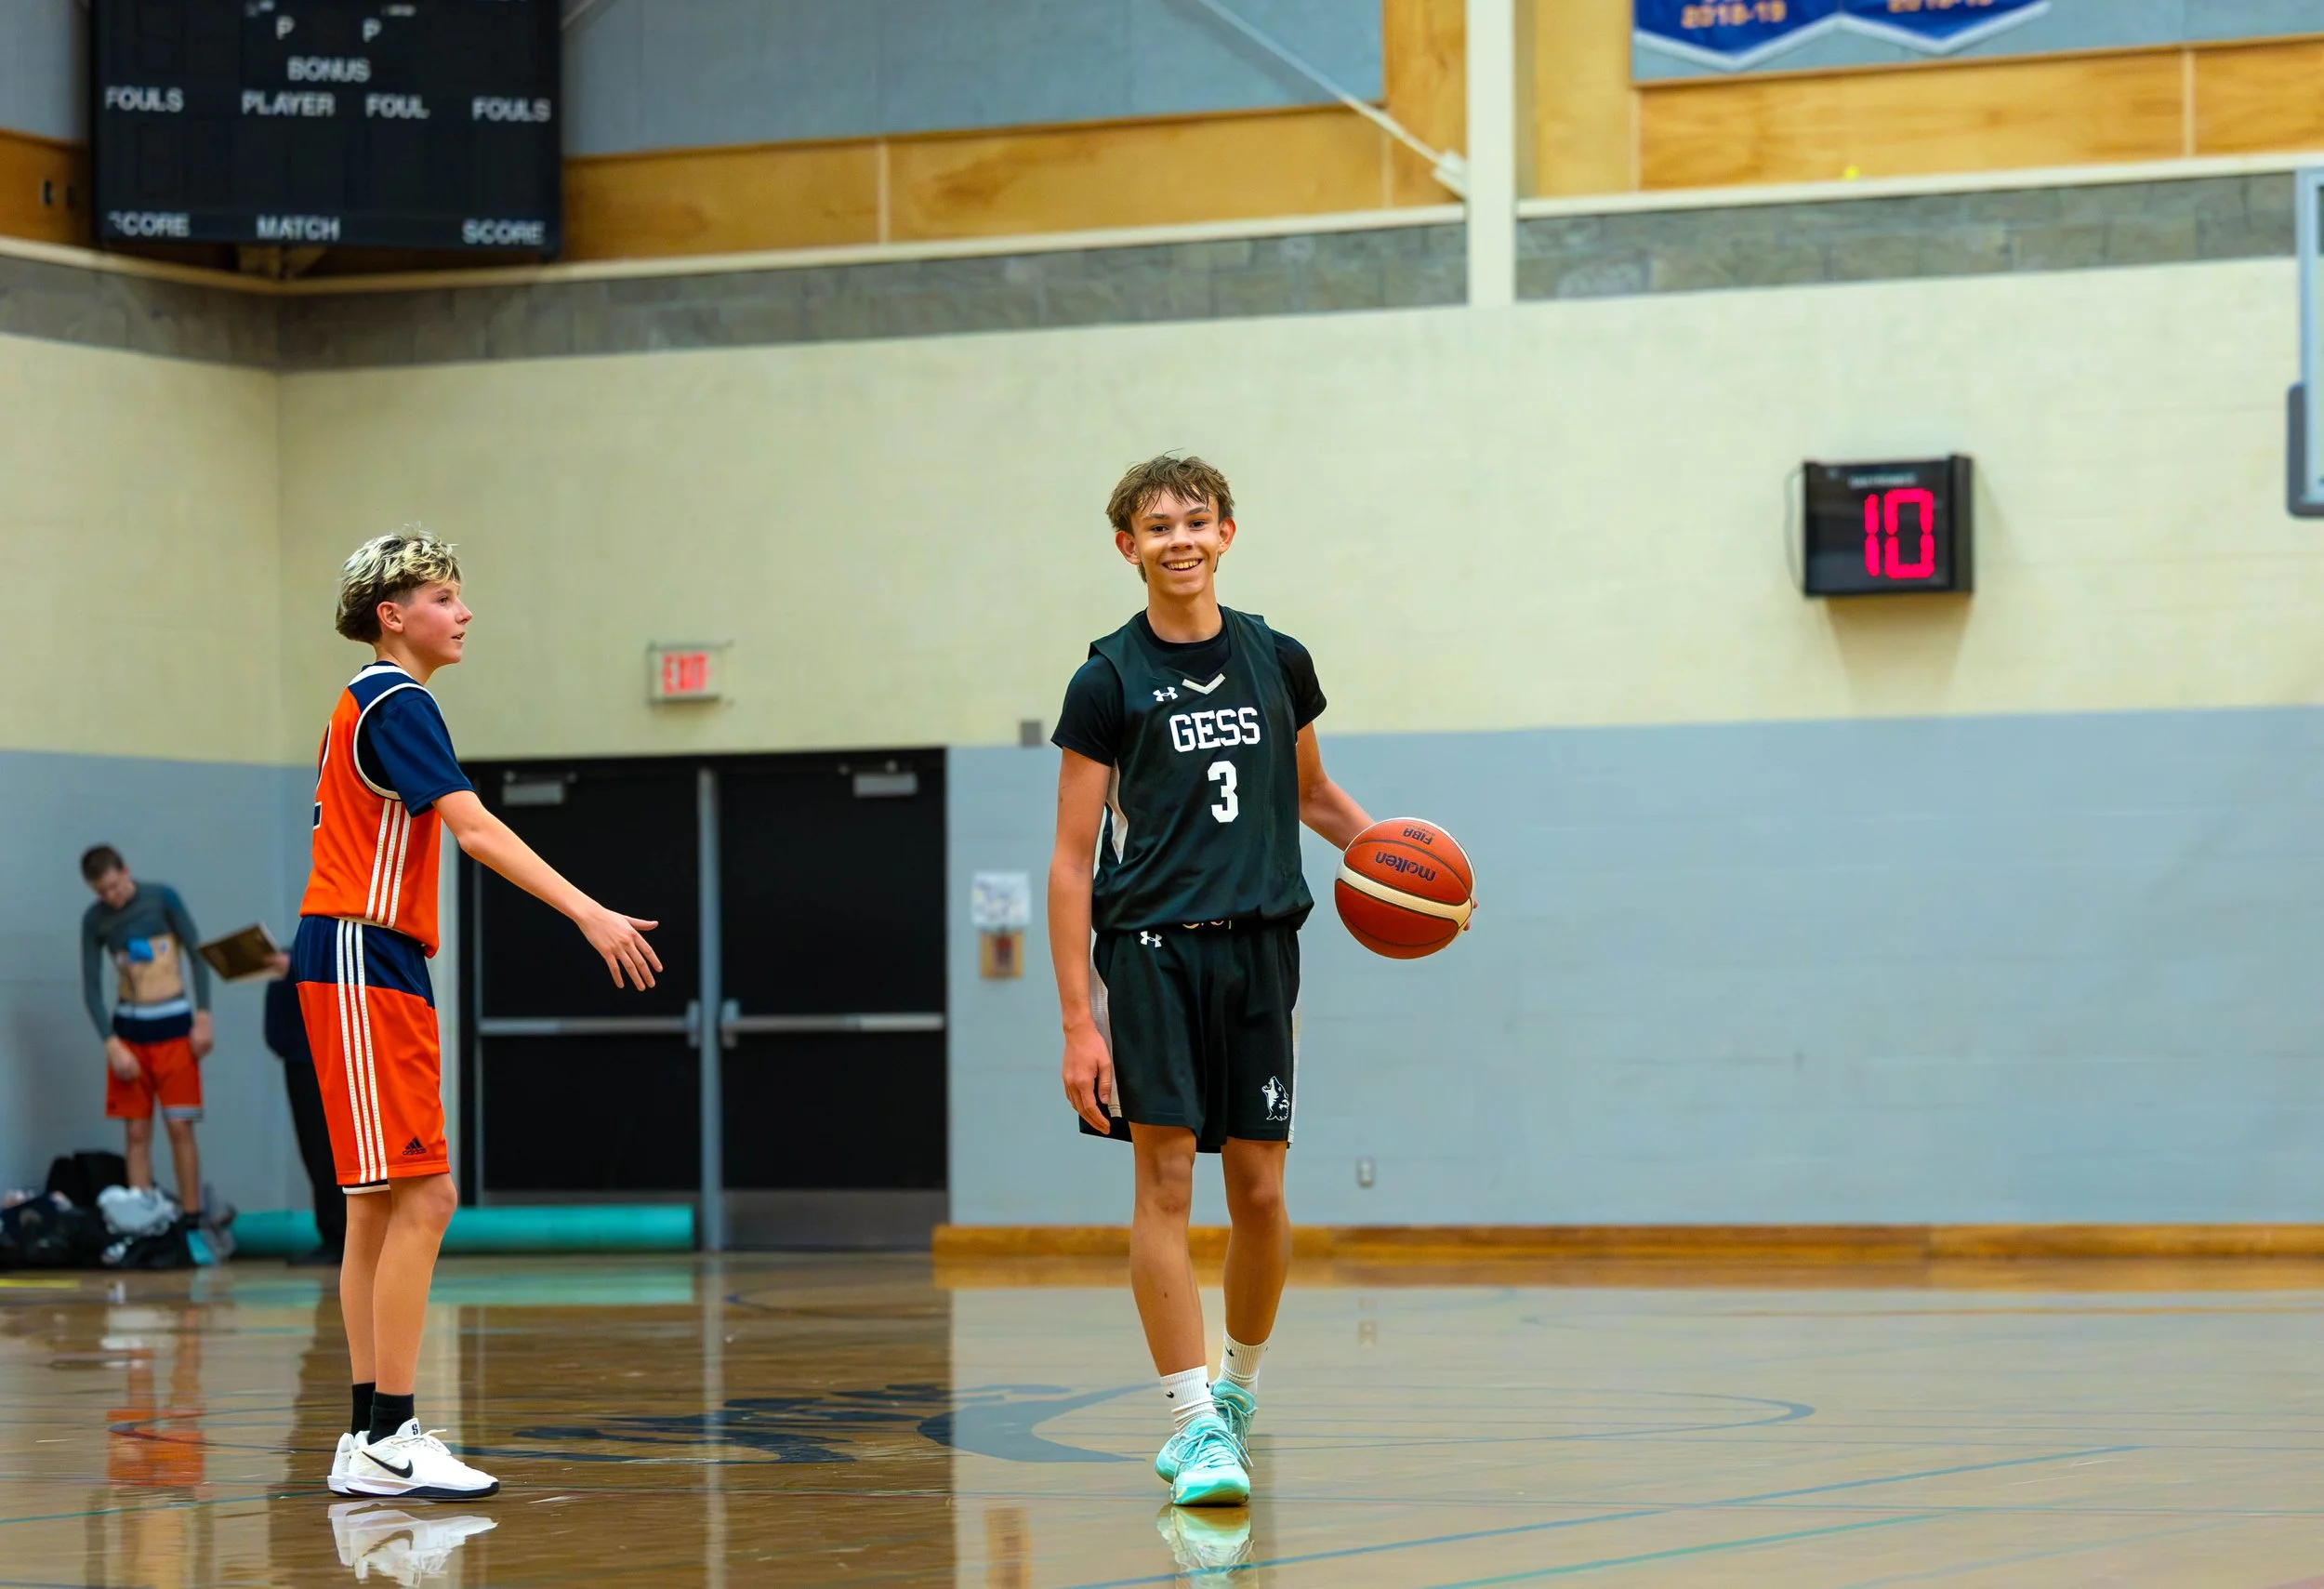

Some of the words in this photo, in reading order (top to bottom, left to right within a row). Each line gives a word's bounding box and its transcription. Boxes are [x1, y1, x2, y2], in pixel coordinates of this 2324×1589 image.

[287, 57, 371, 82] BONUS
[105, 86, 184, 113] FOULS
[242, 91, 335, 116] PLAYER
[366, 94, 430, 119] FOUL
[472, 98, 551, 122] FOULS
[257, 216, 340, 240] MATCH
[462, 219, 545, 245] SCORE
[1864, 488, 1934, 579] 10
[1169, 707, 1261, 752] GESS
[1207, 760, 1239, 823] 3
[1403, 828, 1433, 844] FIBA
[1375, 851, 1436, 881] molten
